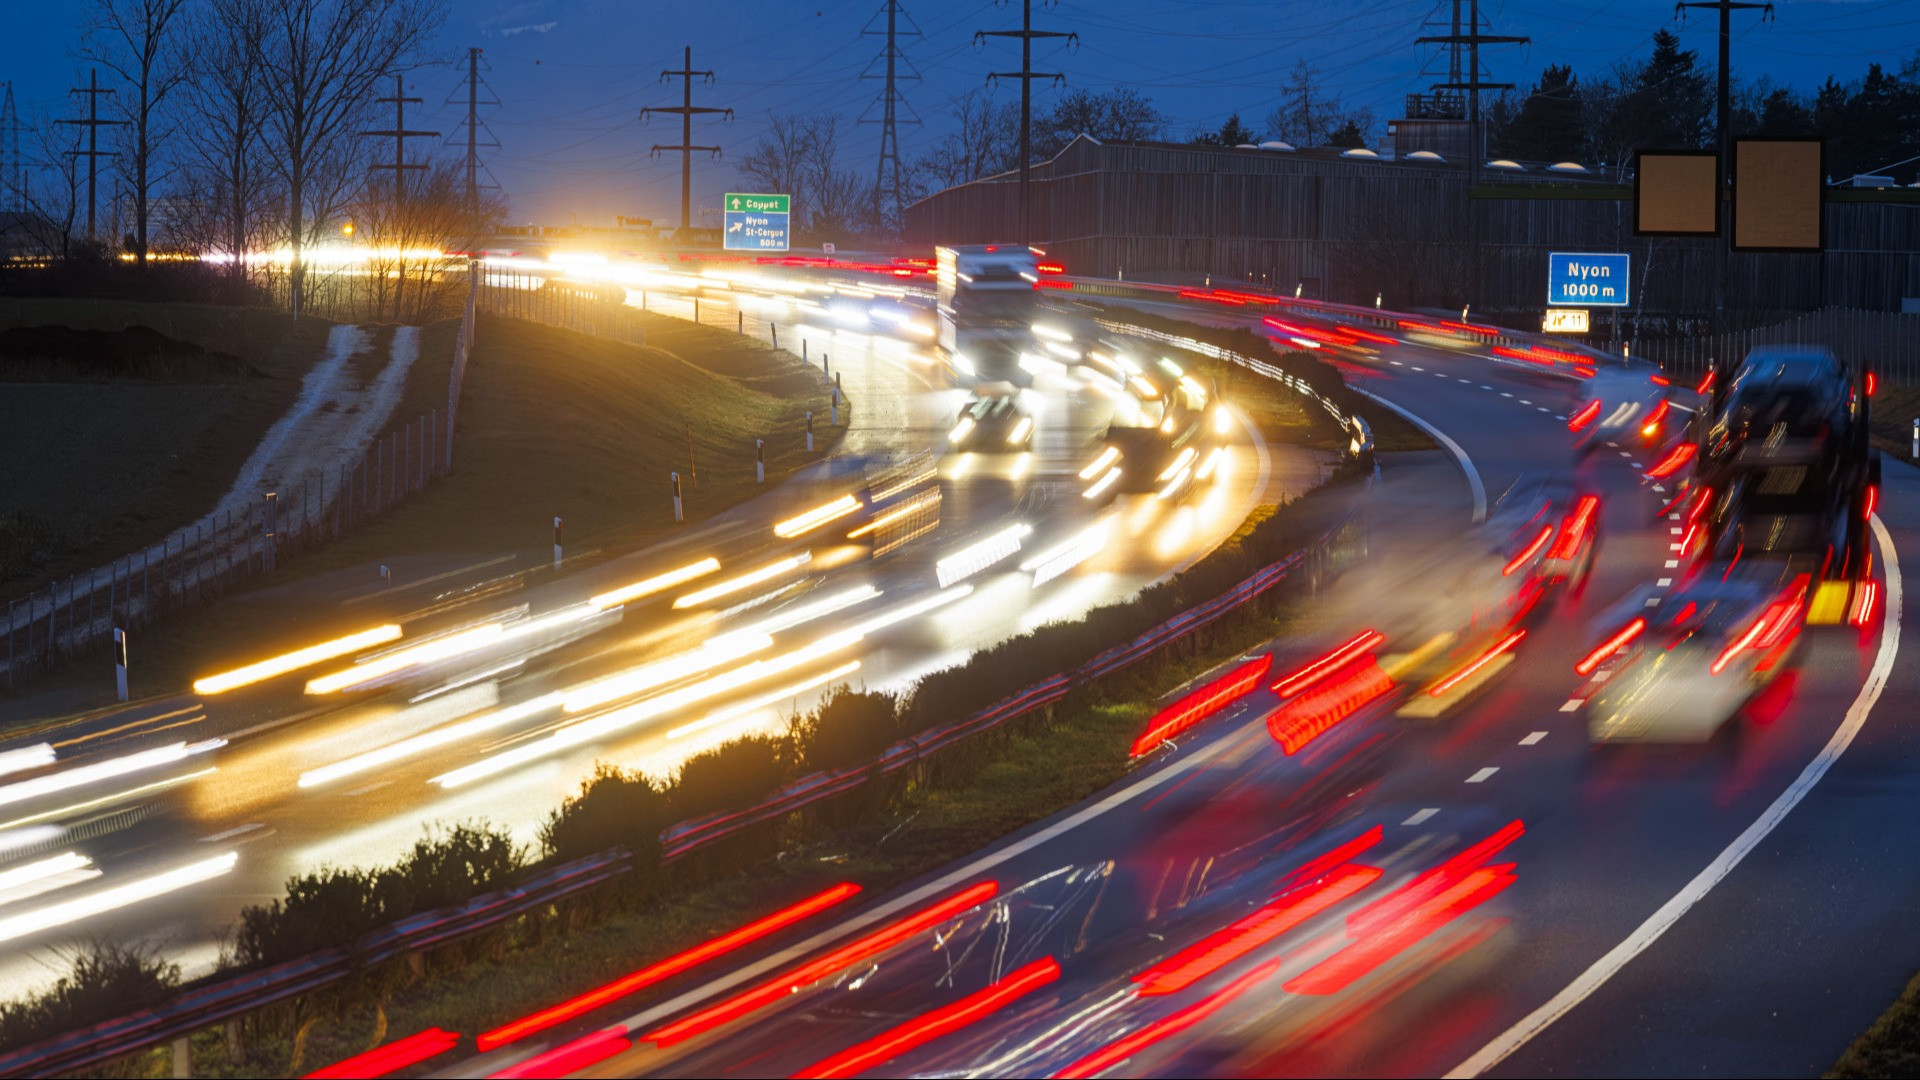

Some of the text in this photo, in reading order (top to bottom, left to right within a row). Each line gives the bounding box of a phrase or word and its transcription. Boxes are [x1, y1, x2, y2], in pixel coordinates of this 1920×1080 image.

[746, 199, 779, 209] Coppet
[745, 216, 768, 226] Nyon
[745, 227, 784, 238] St-Cergue
[760, 239, 776, 247] 500
[1568, 262, 1610, 280] Nyon
[1563, 283, 1615, 297] 1000 m
[1572, 315, 1581, 326] 11
